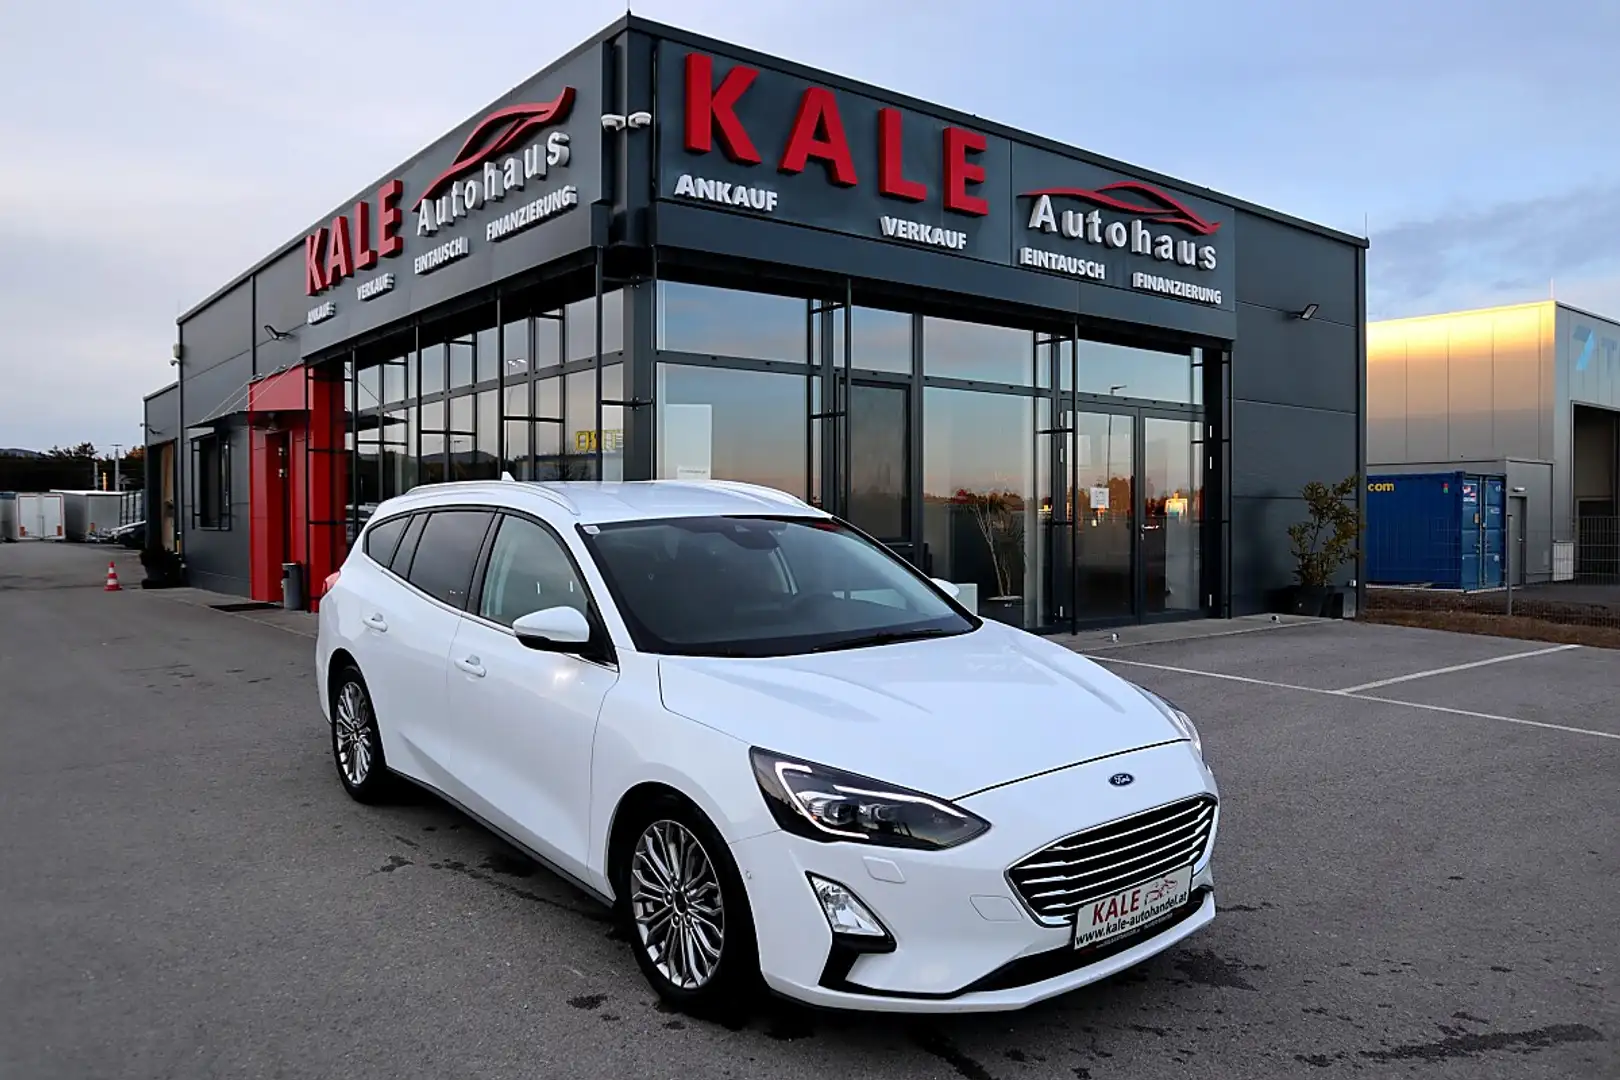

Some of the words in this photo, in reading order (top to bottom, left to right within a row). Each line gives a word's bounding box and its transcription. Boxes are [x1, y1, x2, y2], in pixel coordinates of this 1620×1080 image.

[684, 52, 989, 216] KALE
[416, 130, 570, 236] Autohaus
[674, 174, 778, 212] ANKAUF
[486, 185, 578, 241] FINANZIERUNG
[879, 215, 967, 250] VERKAUF
[1028, 194, 1217, 270] Autohaus
[305, 179, 404, 296] KALE
[414, 236, 469, 275] EINTAUSCH
[1020, 247, 1106, 280] EINTAUSCH
[357, 272, 395, 301] VERKAUF
[1132, 272, 1222, 305] FINANZIERUNG
[1076, 890, 1188, 946] www.kale-autohandel.at
[1092, 888, 1141, 926] KALE
